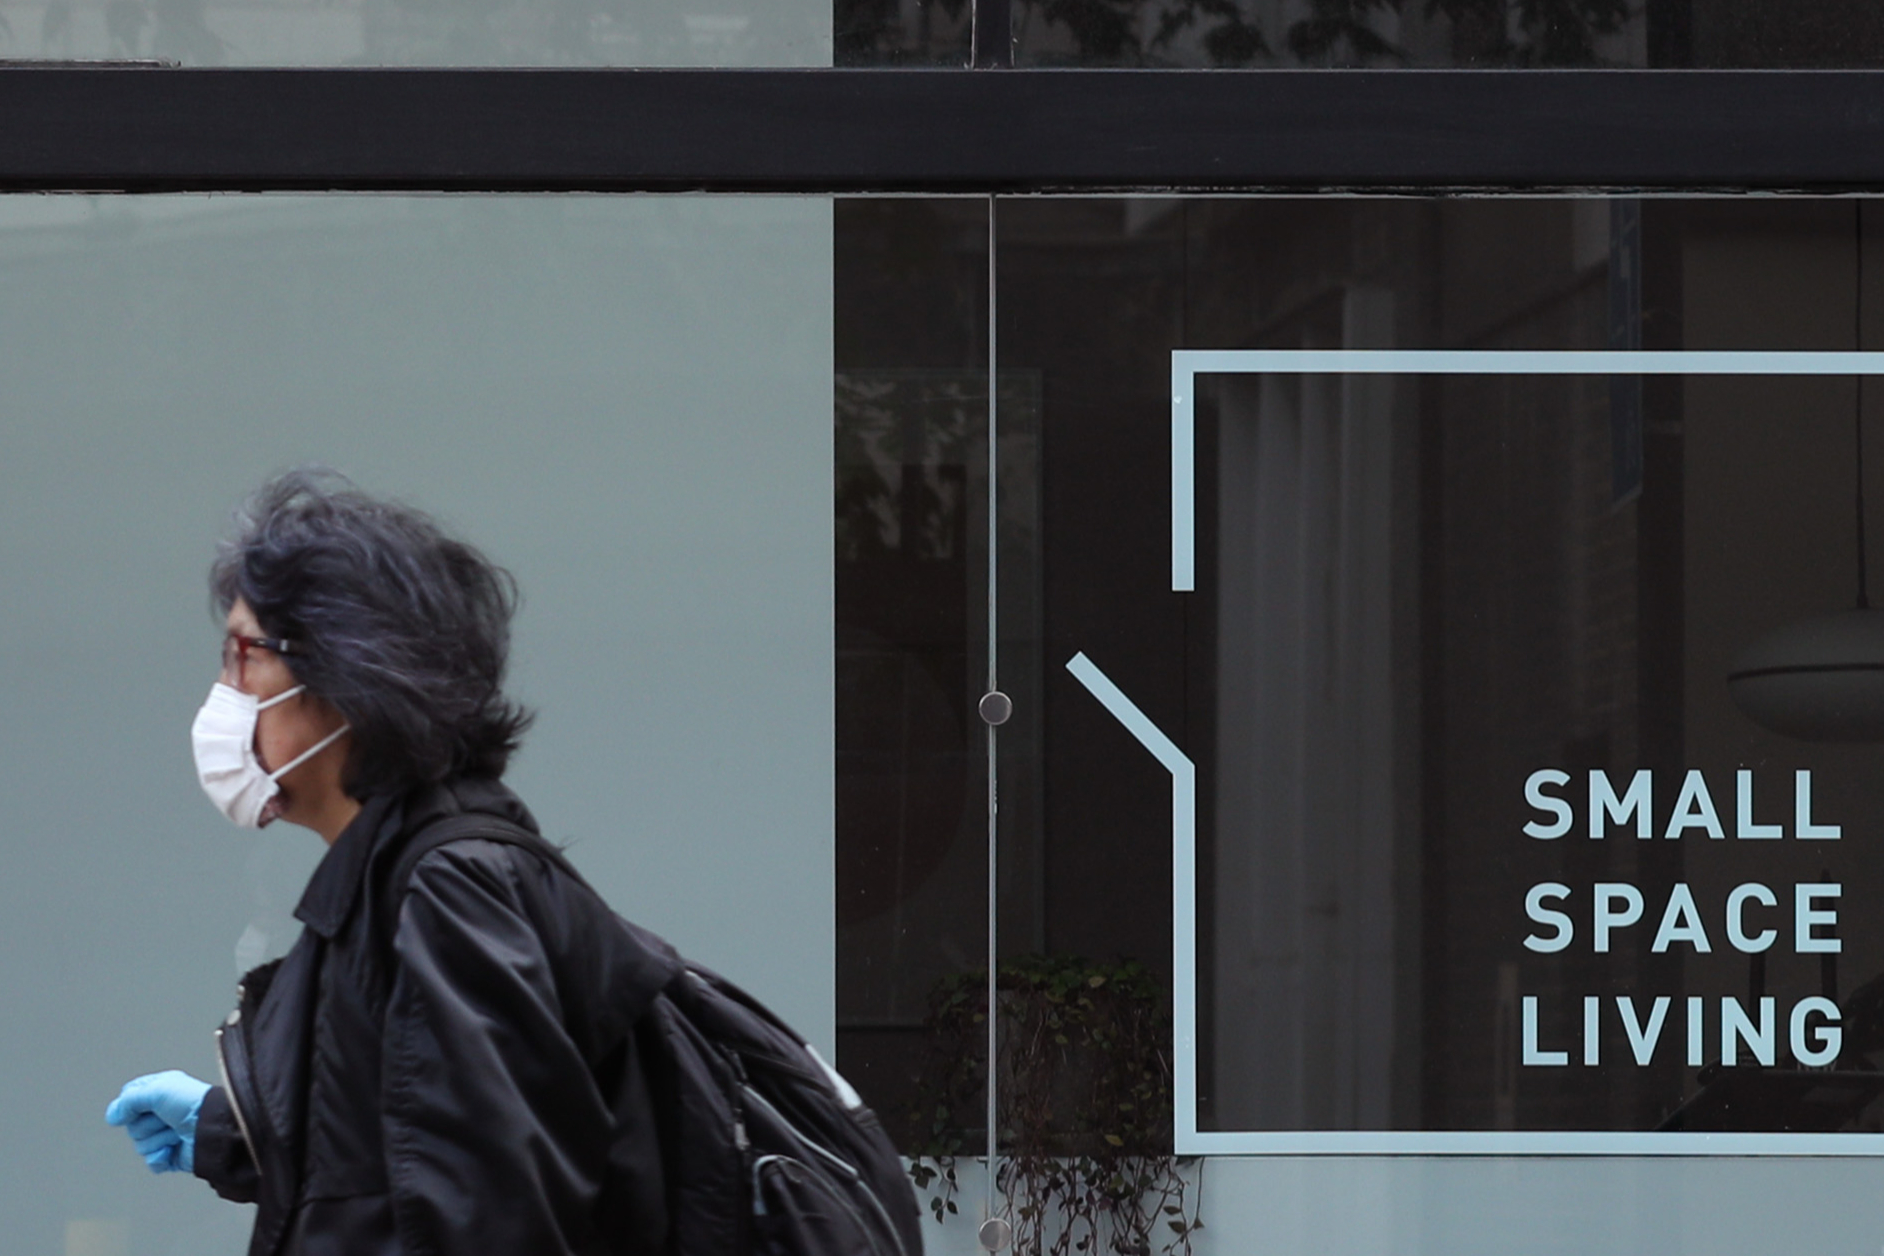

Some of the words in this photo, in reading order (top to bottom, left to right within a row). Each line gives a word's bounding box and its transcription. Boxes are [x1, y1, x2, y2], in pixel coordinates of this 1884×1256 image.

[1522, 769, 1841, 839] SMALL
[1522, 882, 1842, 952] SPACE
[1522, 996, 1842, 1066] LIVING
